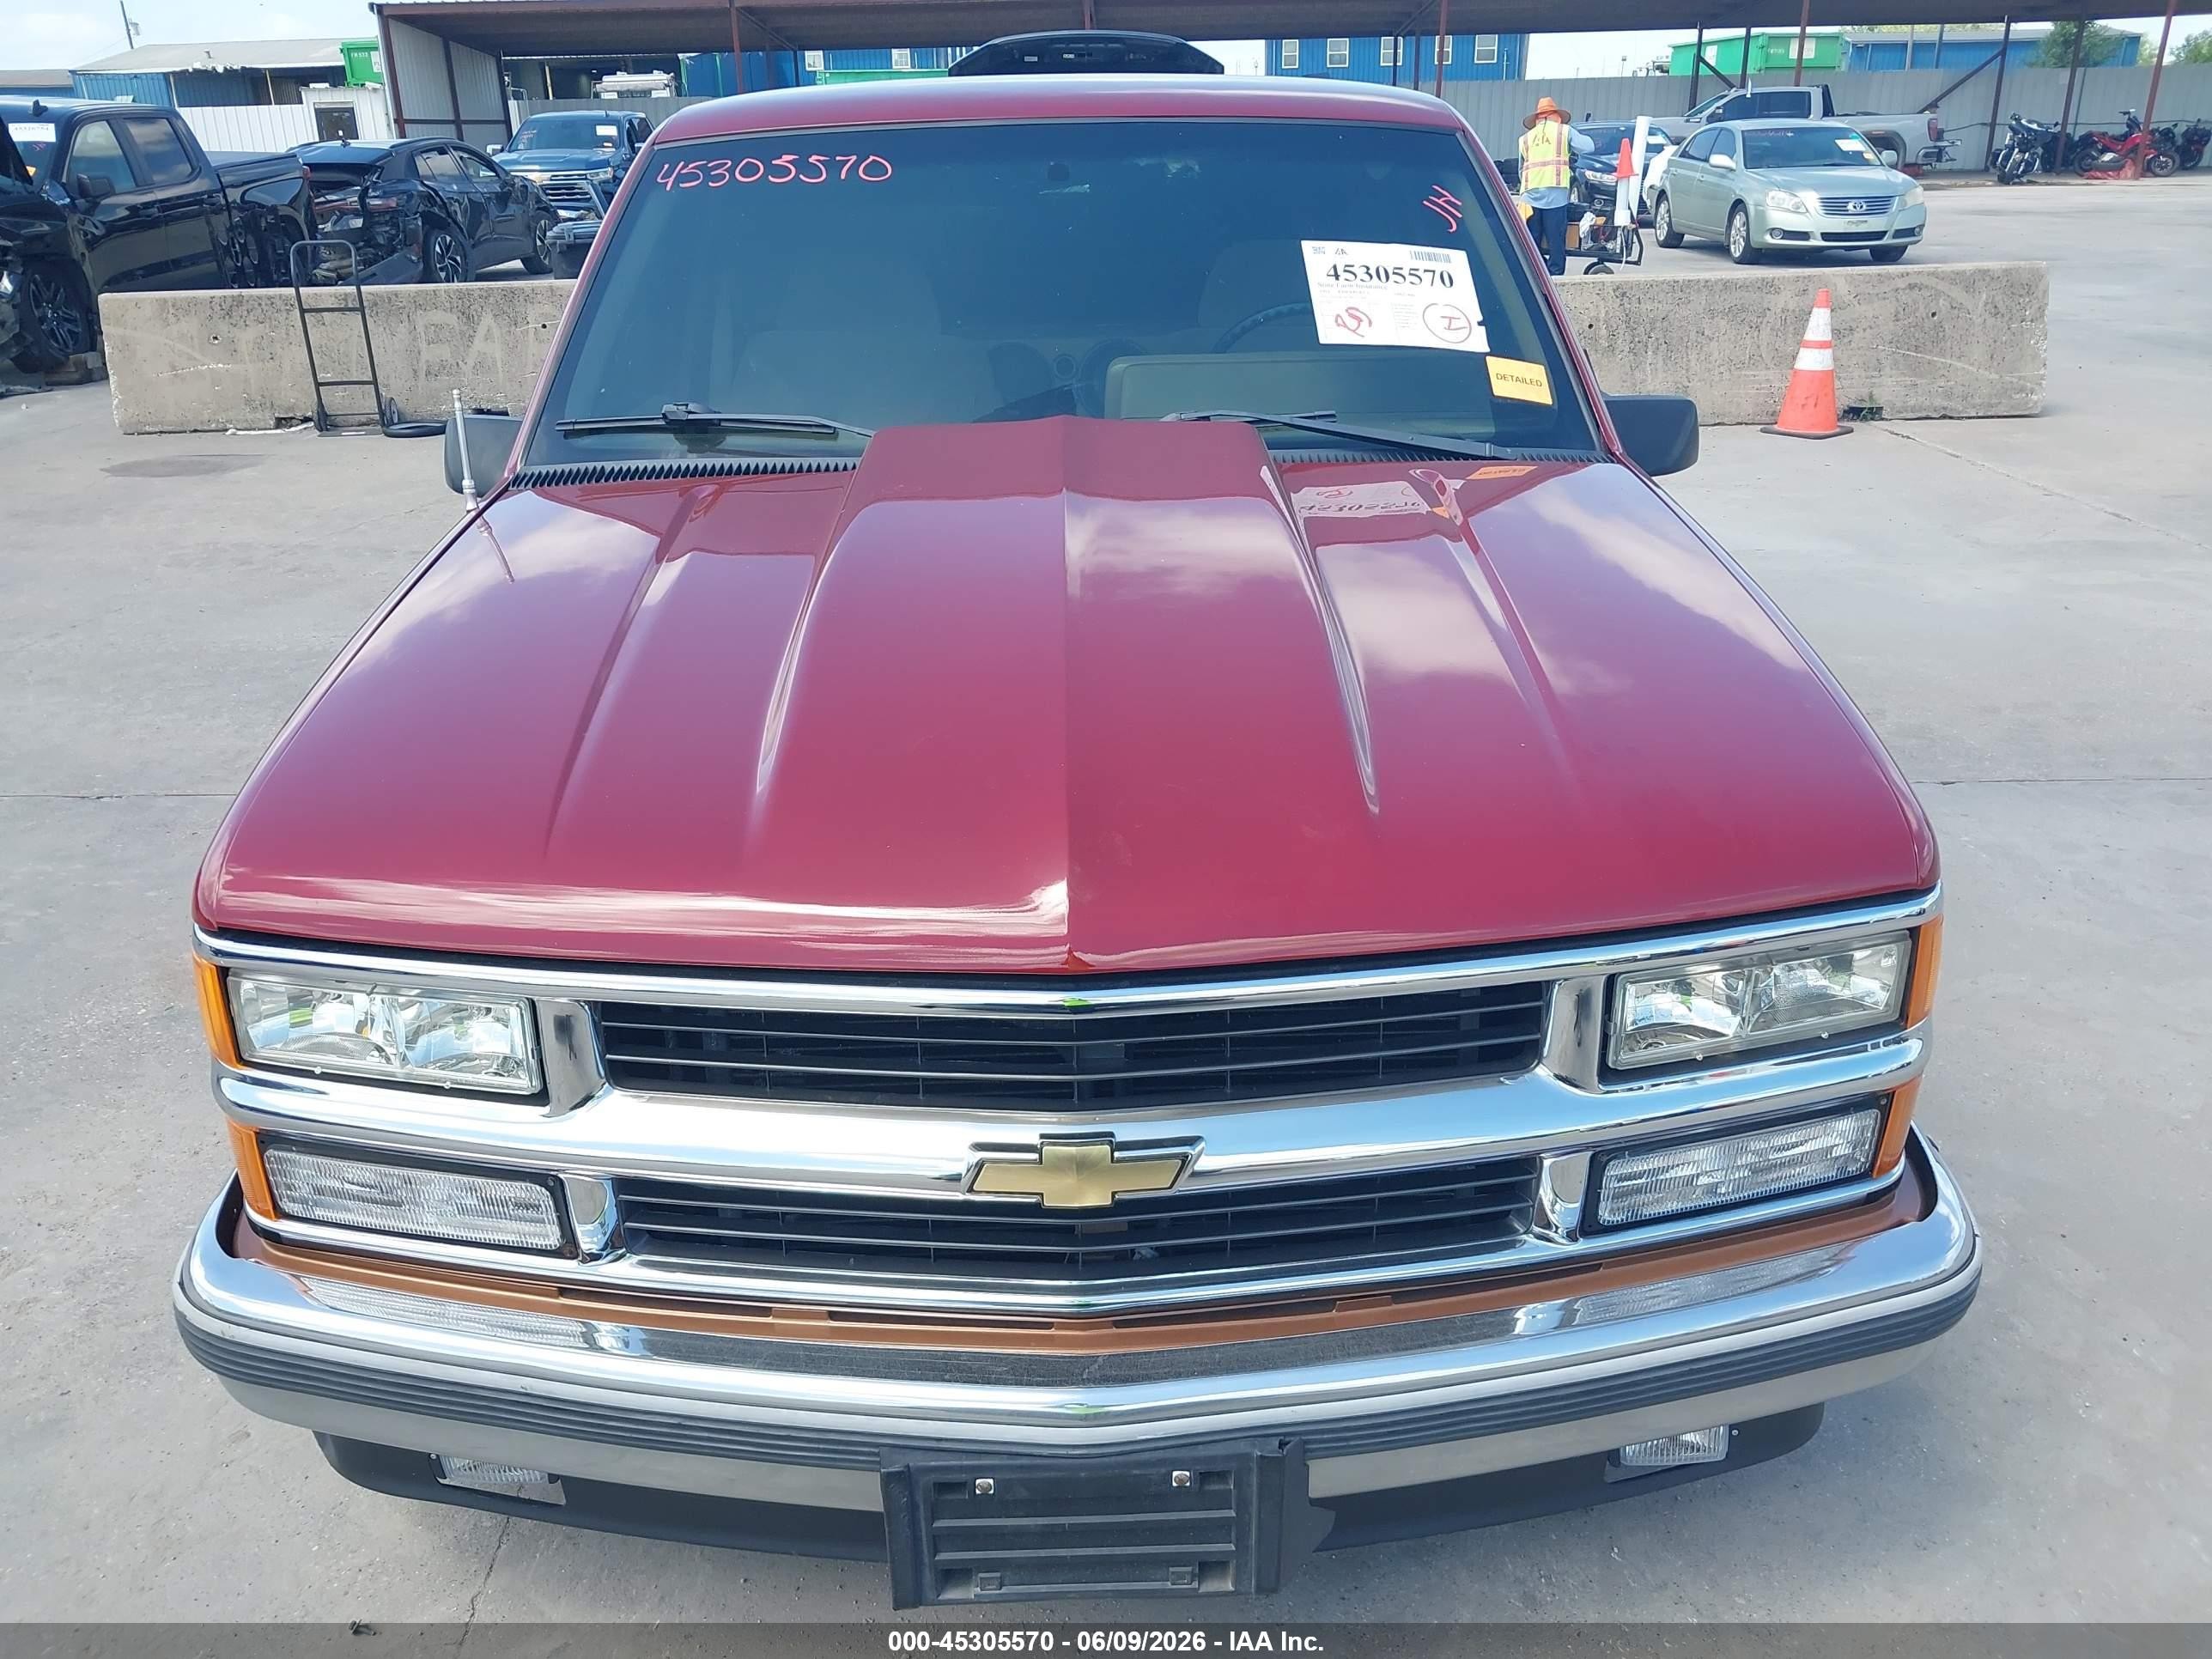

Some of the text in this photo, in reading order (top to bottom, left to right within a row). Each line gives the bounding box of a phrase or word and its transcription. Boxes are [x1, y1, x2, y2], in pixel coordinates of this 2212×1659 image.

[656, 155, 893, 191] 45305570
[1326, 263, 1455, 289] 45305570
[1495, 371, 1542, 388] DETAILED
